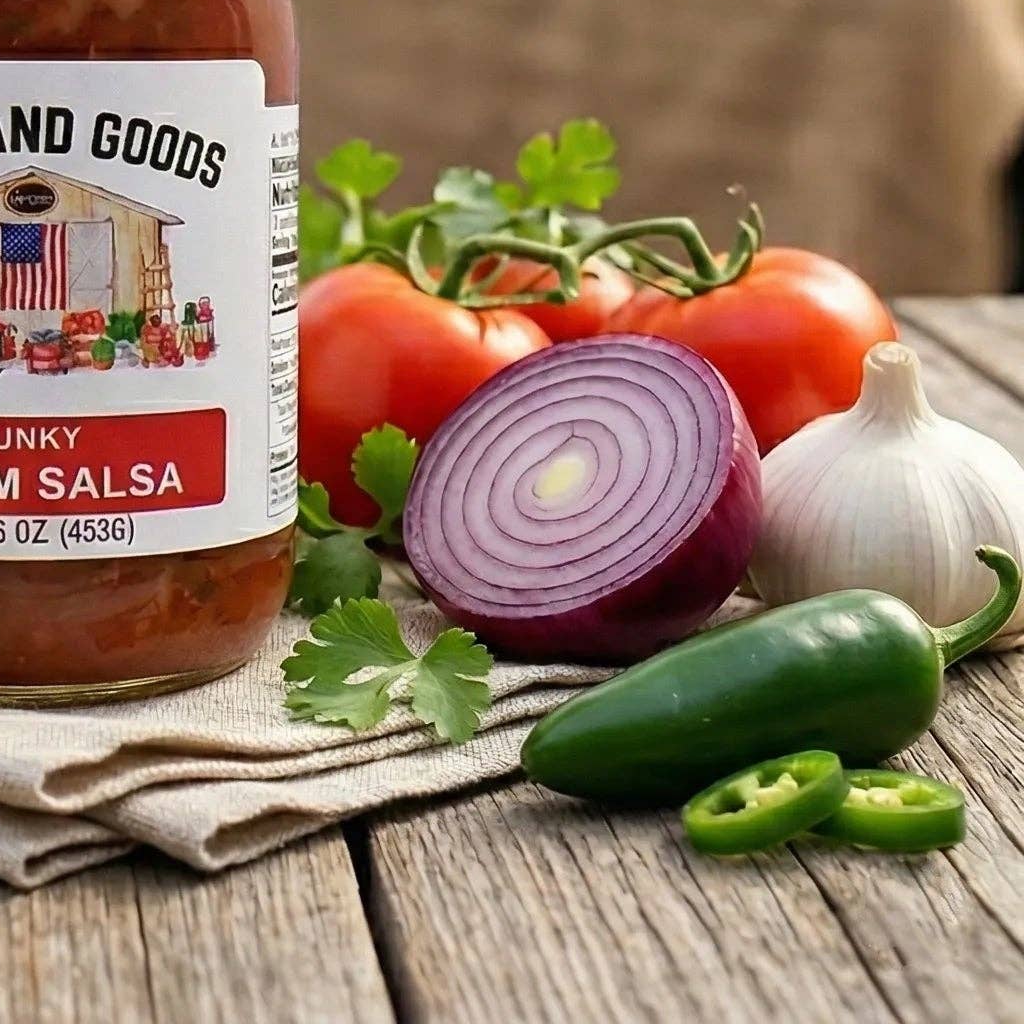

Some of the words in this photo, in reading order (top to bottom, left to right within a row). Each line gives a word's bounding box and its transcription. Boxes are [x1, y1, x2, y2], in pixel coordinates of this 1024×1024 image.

[91, 112, 227, 189] GOODS
[39, 463, 183, 499] SALSA
[16, 520, 48, 543] OZ
[60, 514, 136, 549] (453G)
